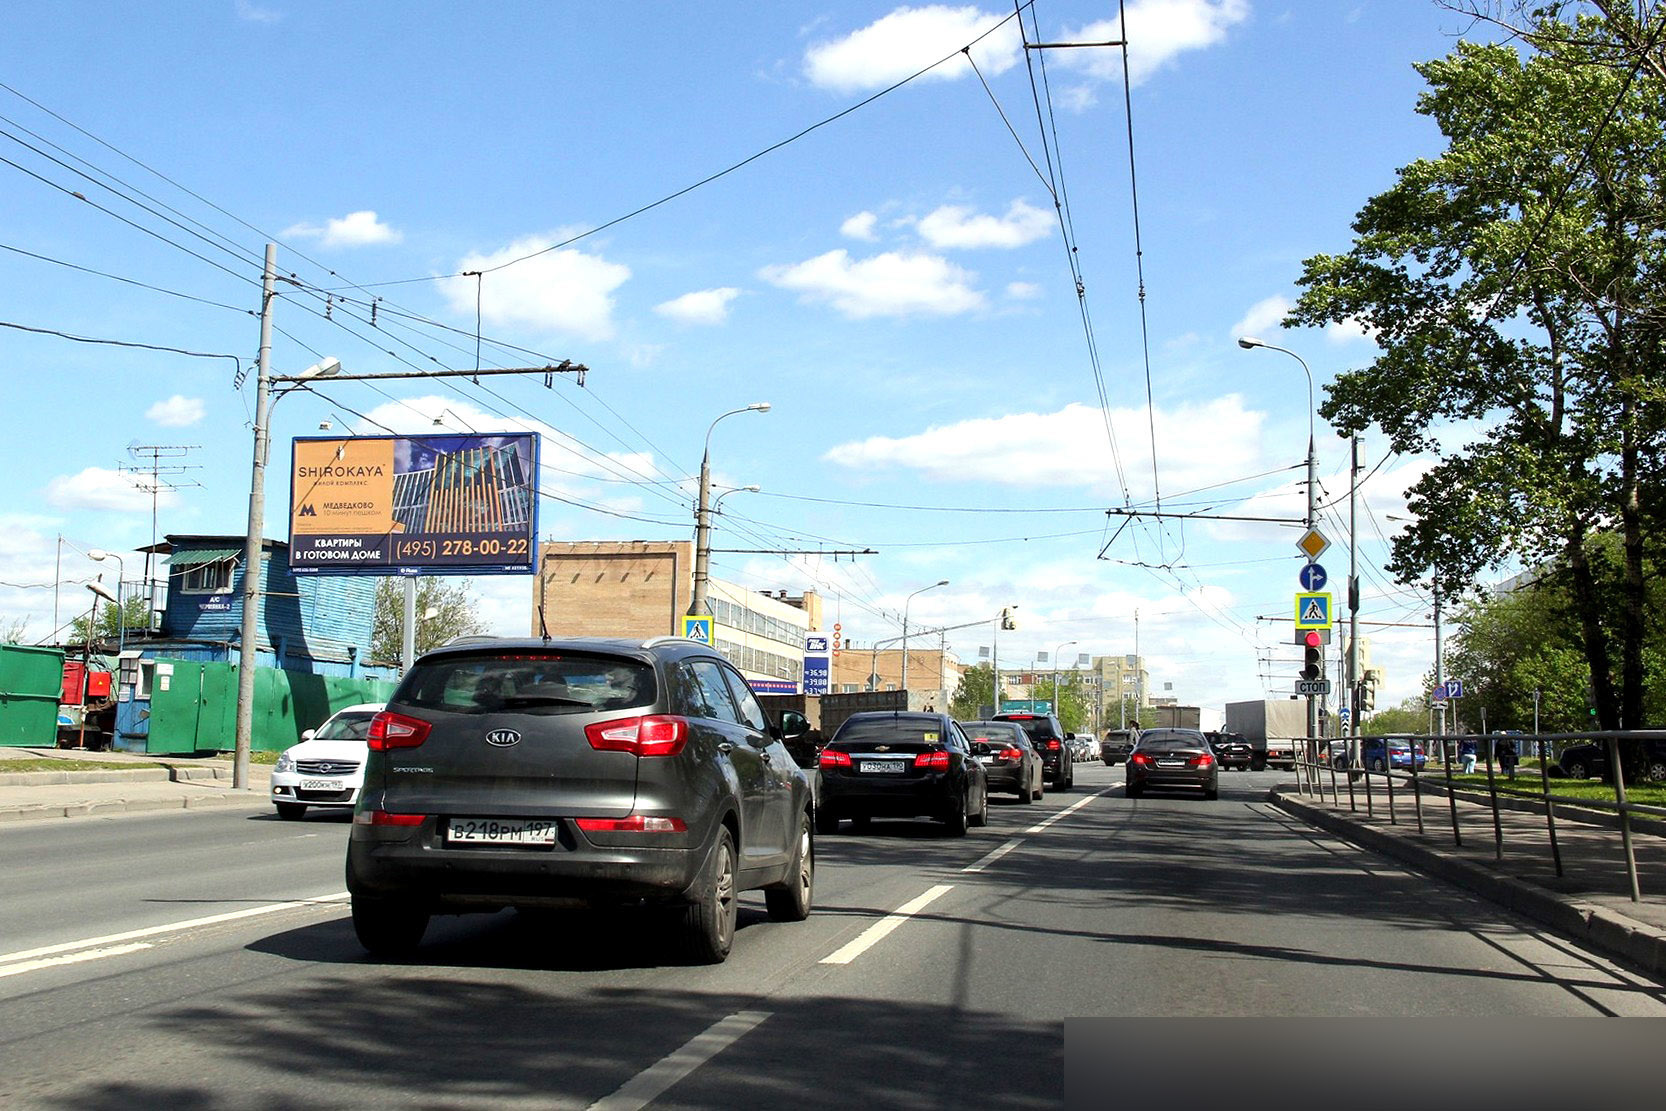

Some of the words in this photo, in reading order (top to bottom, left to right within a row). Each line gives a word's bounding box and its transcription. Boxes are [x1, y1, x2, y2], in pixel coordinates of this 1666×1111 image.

[298, 466, 383, 477] SHIROKAYA
[323, 501, 374, 510] МЕДВЕДКОВО
[314, 538, 362, 548] КВАРТИРЫ
[396, 540, 437, 560] (495)
[441, 539, 528, 556] 278-00-22
[295, 550, 302, 560] В
[303, 550, 350, 560] ГОТОВОМ
[350, 550, 381, 560] ДОМЕ
[1300, 682, 1325, 692] СТОП
[492, 732, 515, 743] KIA
[526, 821, 551, 836] 197
